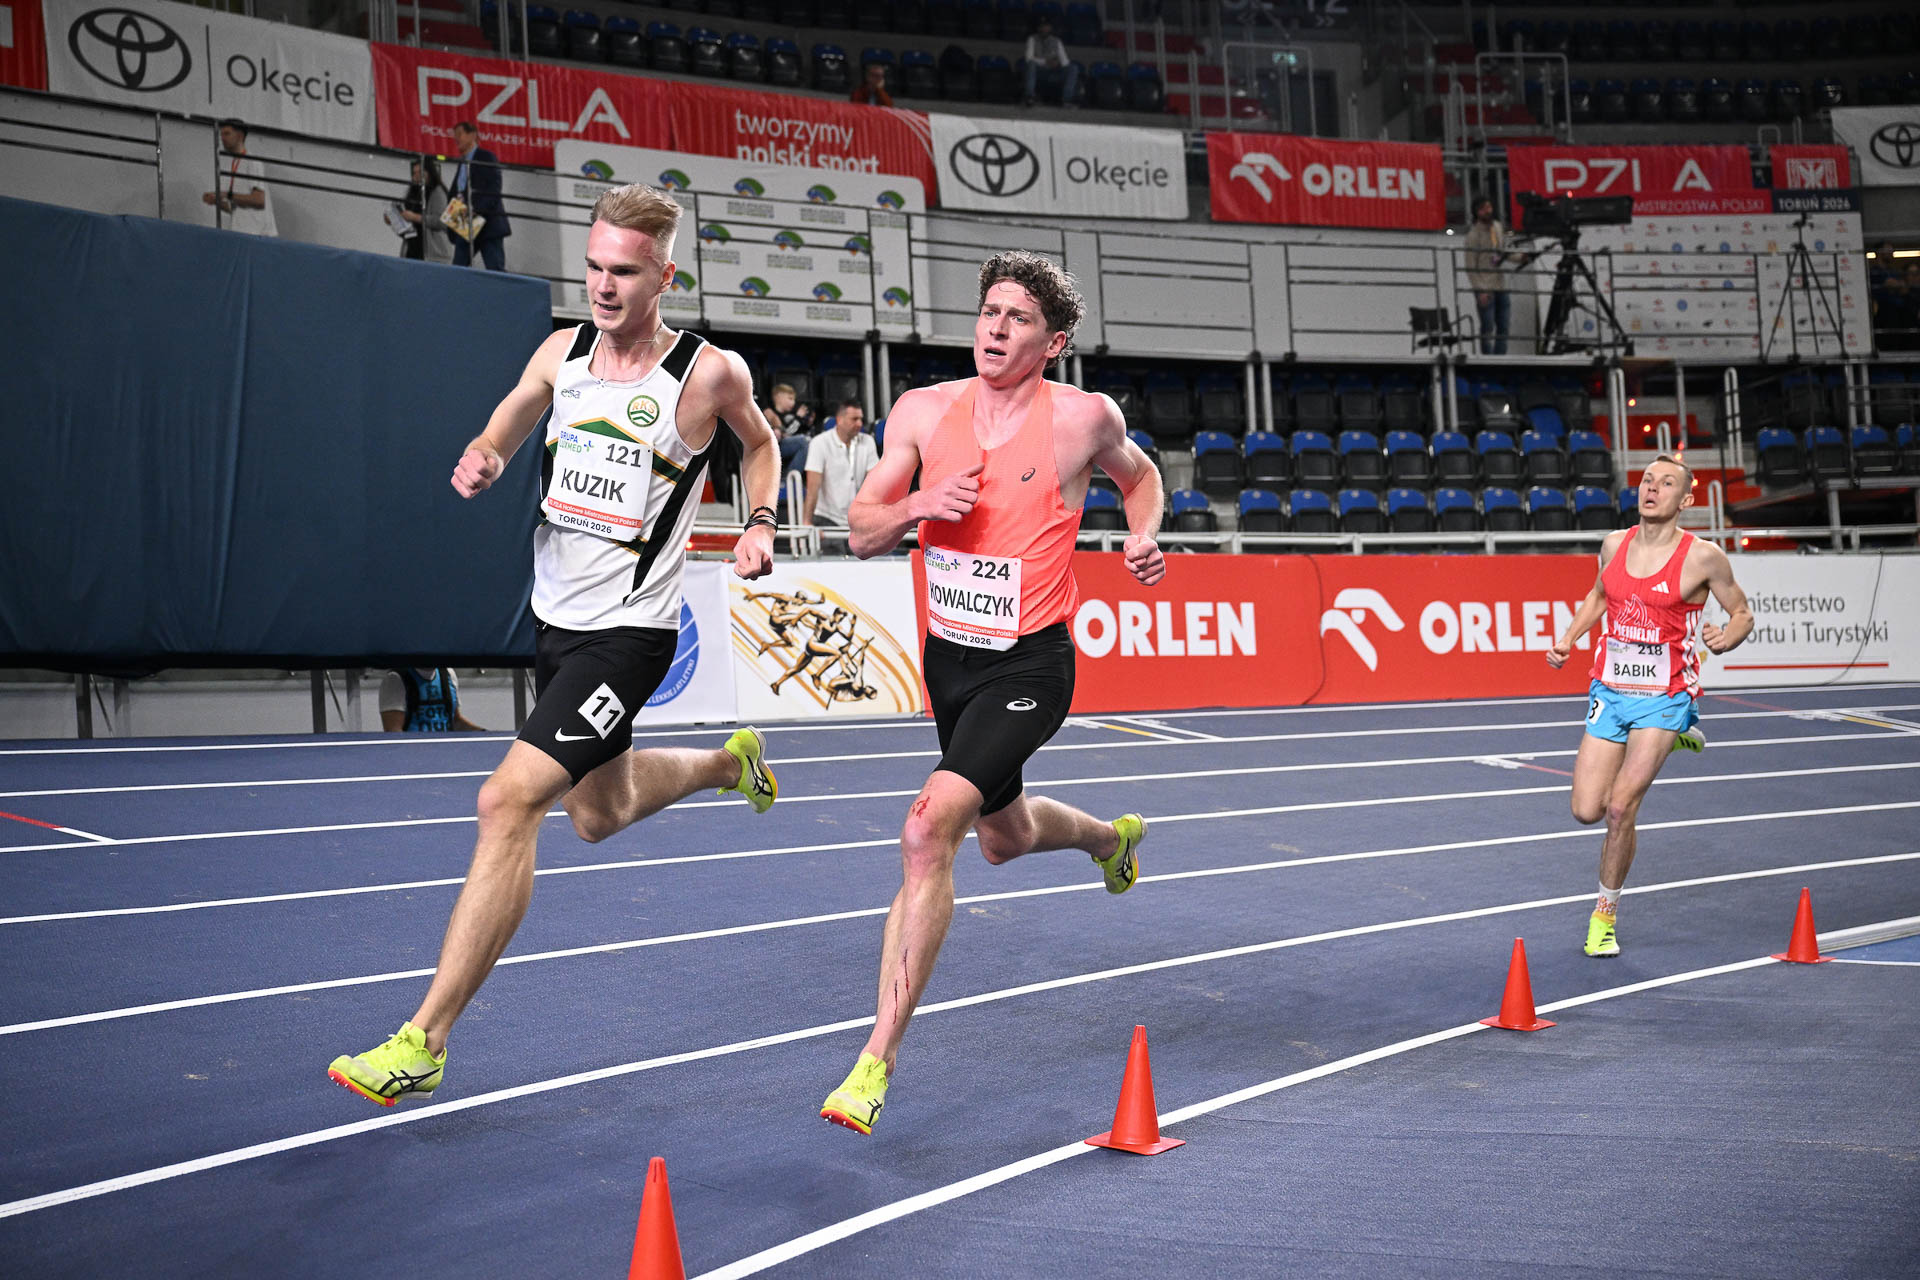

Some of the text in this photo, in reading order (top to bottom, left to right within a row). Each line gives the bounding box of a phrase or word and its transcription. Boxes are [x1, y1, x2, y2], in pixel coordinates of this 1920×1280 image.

[227, 54, 355, 105] Okęcie
[417, 66, 631, 139] PZLA
[734, 108, 853, 152] tworzymy
[737, 141, 883, 175] polski sport
[1066, 156, 1169, 191] Okęcie
[1302, 162, 1426, 201] ORLEN
[1633, 199, 1765, 215] MISTRZOSTWA POLSKI
[1779, 194, 1852, 212] TORUŃ 2026
[632, 400, 656, 415] RKS
[605, 443, 642, 468] 121
[560, 467, 627, 503] KUZIK
[558, 513, 612, 534] TORUŃ 2026
[972, 559, 1011, 581] 224
[929, 580, 1014, 618] KOWALCZYK
[1720, 592, 1845, 613] nisterstwo
[942, 628, 992, 646] TORUŃ 2026
[1073, 598, 1257, 658] ORLEN
[1419, 600, 1590, 654] ORLEN
[1721, 620, 1889, 646] ortu i Turystyki
[1638, 644, 1663, 656] 218
[1614, 662, 1657, 678] BABIK
[591, 695, 621, 731] 11
